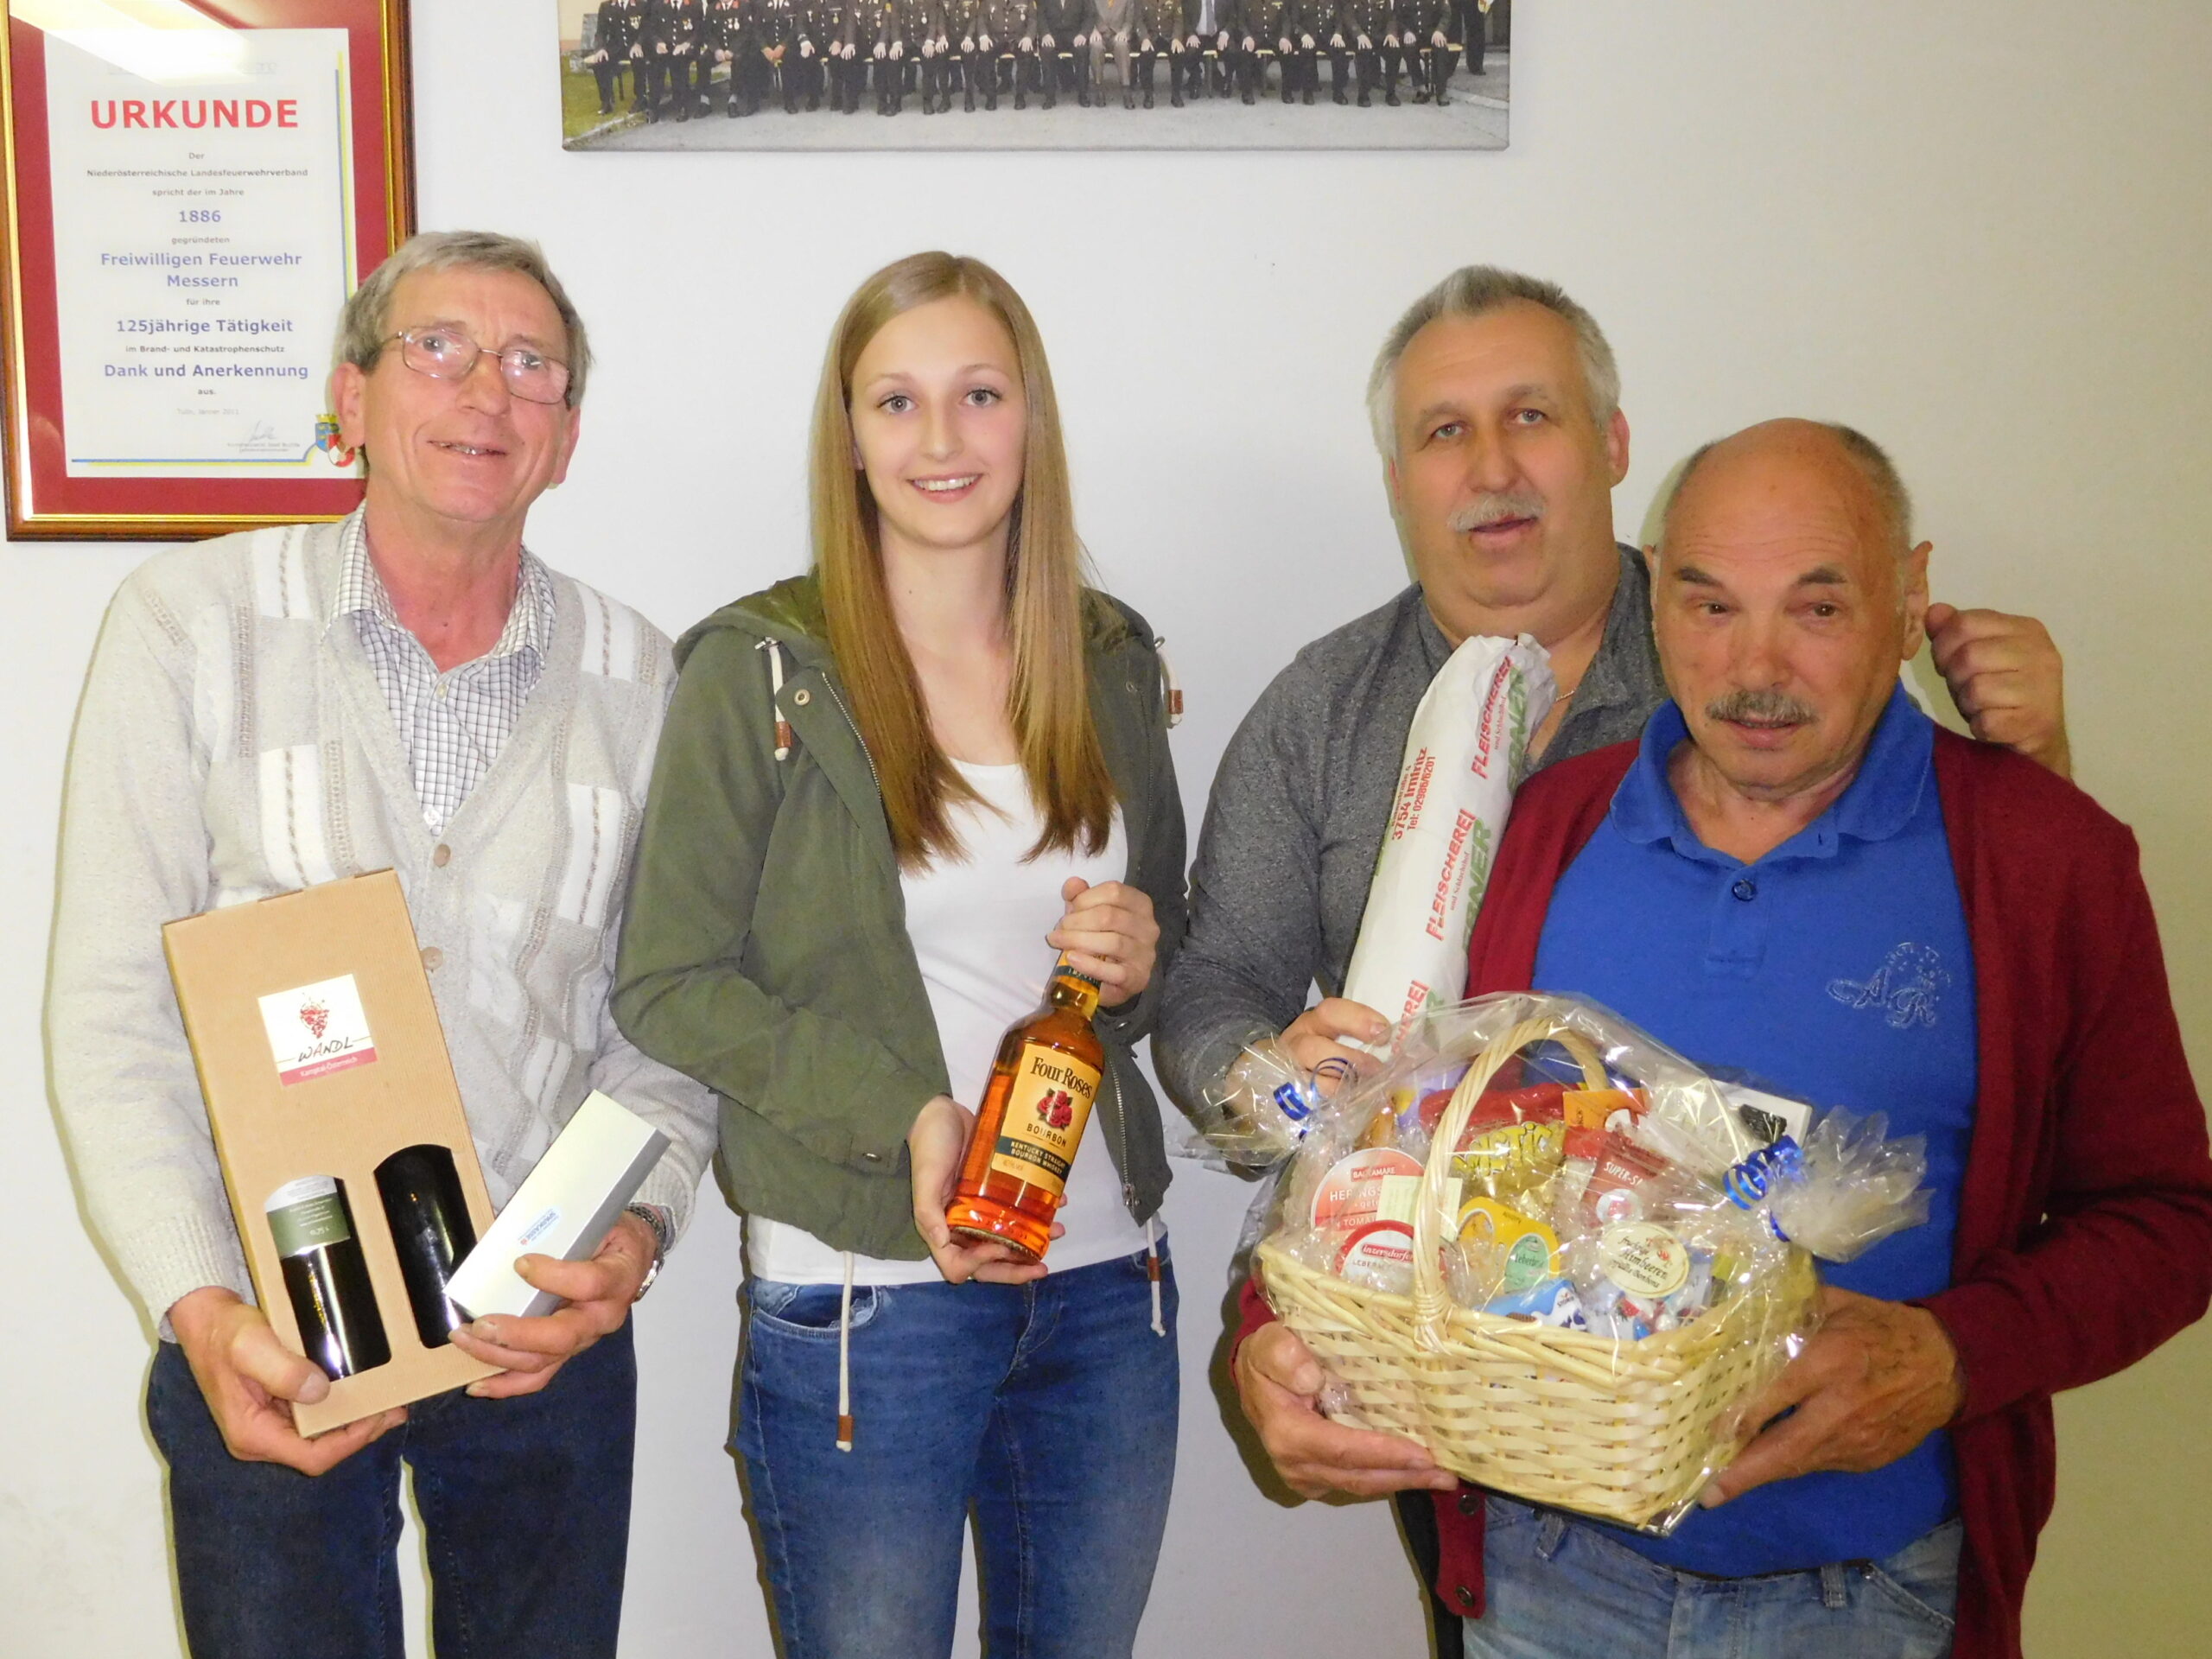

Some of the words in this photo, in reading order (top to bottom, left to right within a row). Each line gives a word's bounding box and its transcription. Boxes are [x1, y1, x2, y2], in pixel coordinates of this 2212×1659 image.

[91, 99, 299, 129] URKUNDE
[153, 188, 183, 197] spricht
[179, 210, 221, 222] 1886
[171, 236, 230, 245] gegründeten
[101, 253, 202, 267] Freiwilligen
[209, 253, 302, 265] Feuerwehr
[167, 275, 238, 287] Messern
[117, 320, 210, 334] 125jährige
[216, 320, 293, 334] Tätigkeit
[105, 364, 148, 377] Dank
[155, 364, 186, 377] und
[193, 364, 308, 379] Anerkennung
[1471, 655, 1513, 779] FLEISCHEREI
[1392, 802, 1411, 841] 3754
[1408, 814, 1420, 831] Tel:
[1425, 808, 1478, 941] FLEISCHEREI
[298, 1037, 353, 1063] WANDL
[1030, 1056, 1065, 1082] Four
[1061, 1067, 1093, 1099] Roses
[1027, 1123, 1067, 1147] BOURBON
[1011, 1141, 1043, 1156] KENTUCKY
[1011, 1148, 1041, 1163] BOURBON
[1042, 1160, 1063, 1174] WHISKEY
[1352, 1166, 1395, 1179] BAAMARE
[1363, 1247, 1413, 1261] Inzersdorfe
